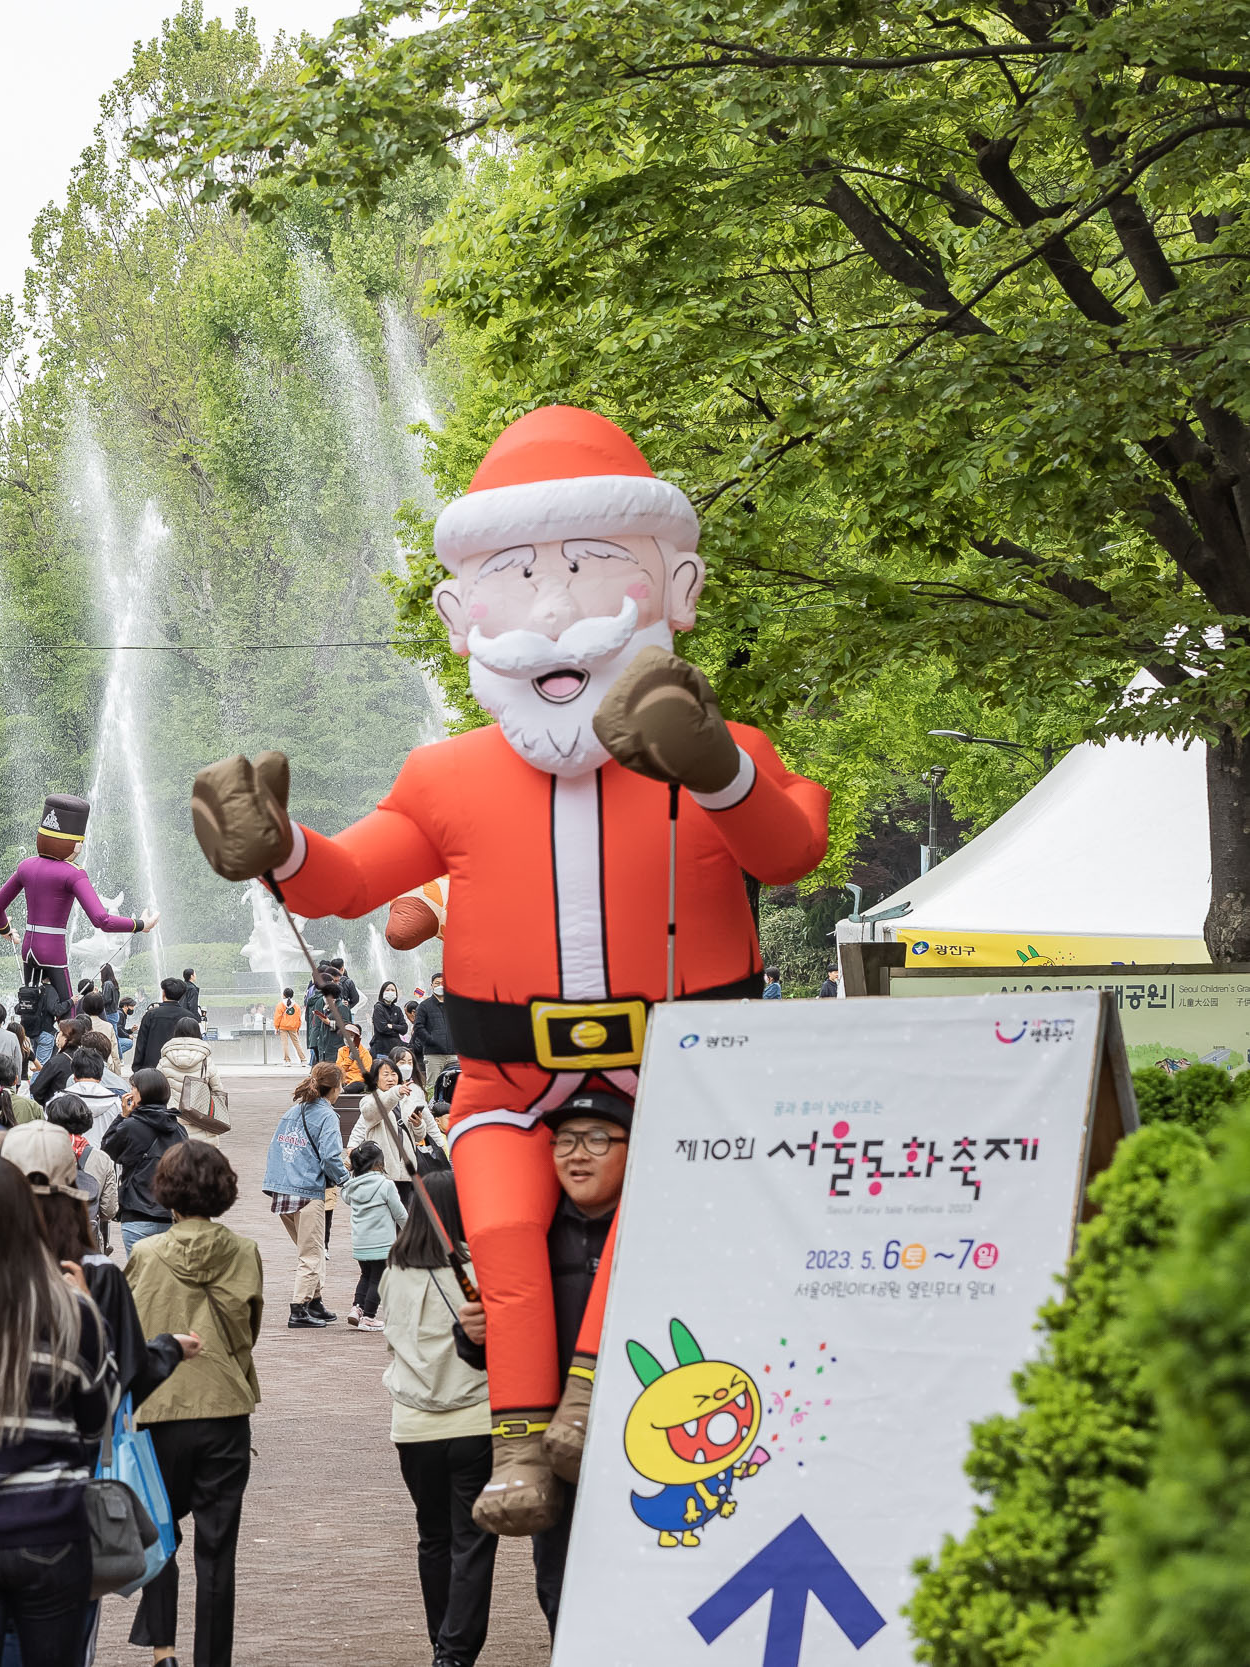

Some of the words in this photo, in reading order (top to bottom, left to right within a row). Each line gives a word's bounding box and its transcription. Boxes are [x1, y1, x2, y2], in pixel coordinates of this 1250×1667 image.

[934, 943, 976, 957] 광진구
[1178, 984, 1198, 993] Seoul
[1200, 984, 1234, 993] Children's
[675, 1136, 755, 1161] 제10회
[806, 1250, 854, 1270] 2023.
[860, 1251, 876, 1270] 5.
